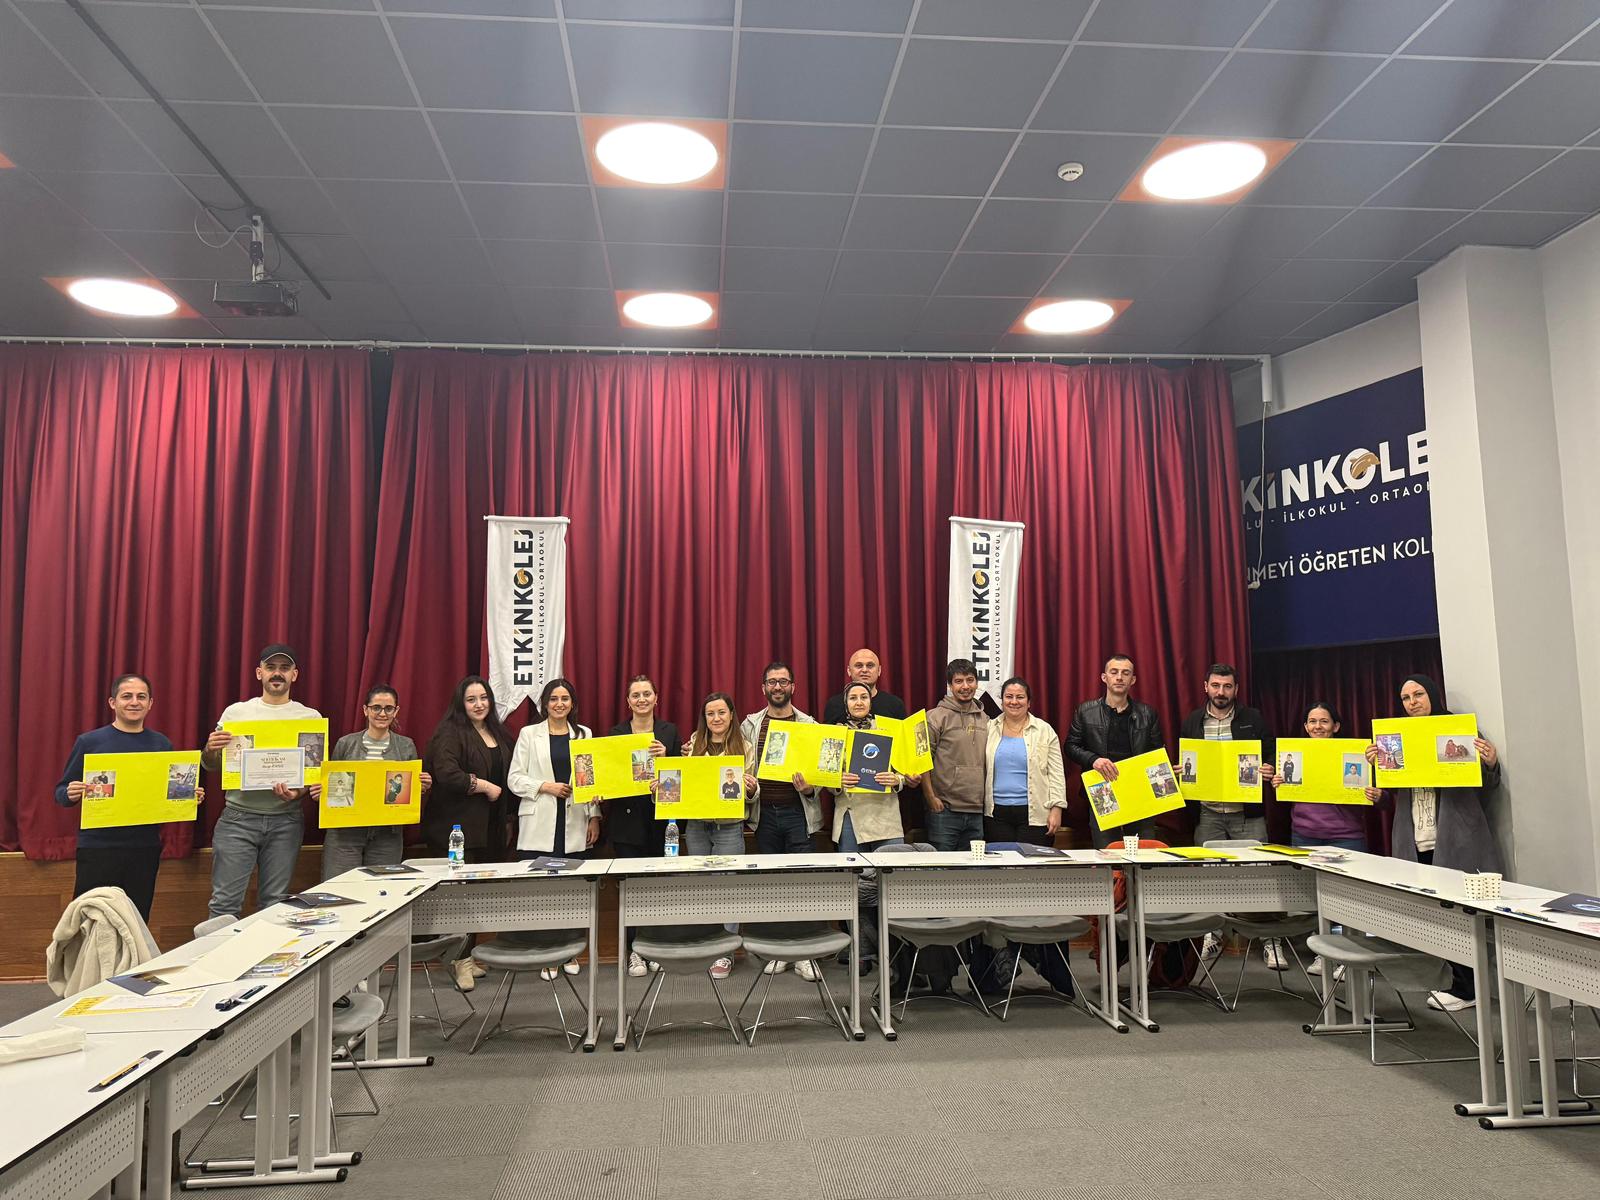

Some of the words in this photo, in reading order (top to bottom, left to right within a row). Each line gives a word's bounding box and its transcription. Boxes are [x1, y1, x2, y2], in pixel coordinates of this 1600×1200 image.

[1247, 555, 1294, 581] MEYİ
[1299, 544, 1386, 574] ÖĞRETEN
[1393, 536, 1431, 560] KOL
[1283, 501, 1347, 524] İLKOKUL
[513, 529, 534, 686] ETKİNKOLEJ
[972, 532, 991, 682] ETKİNKOLEJ
